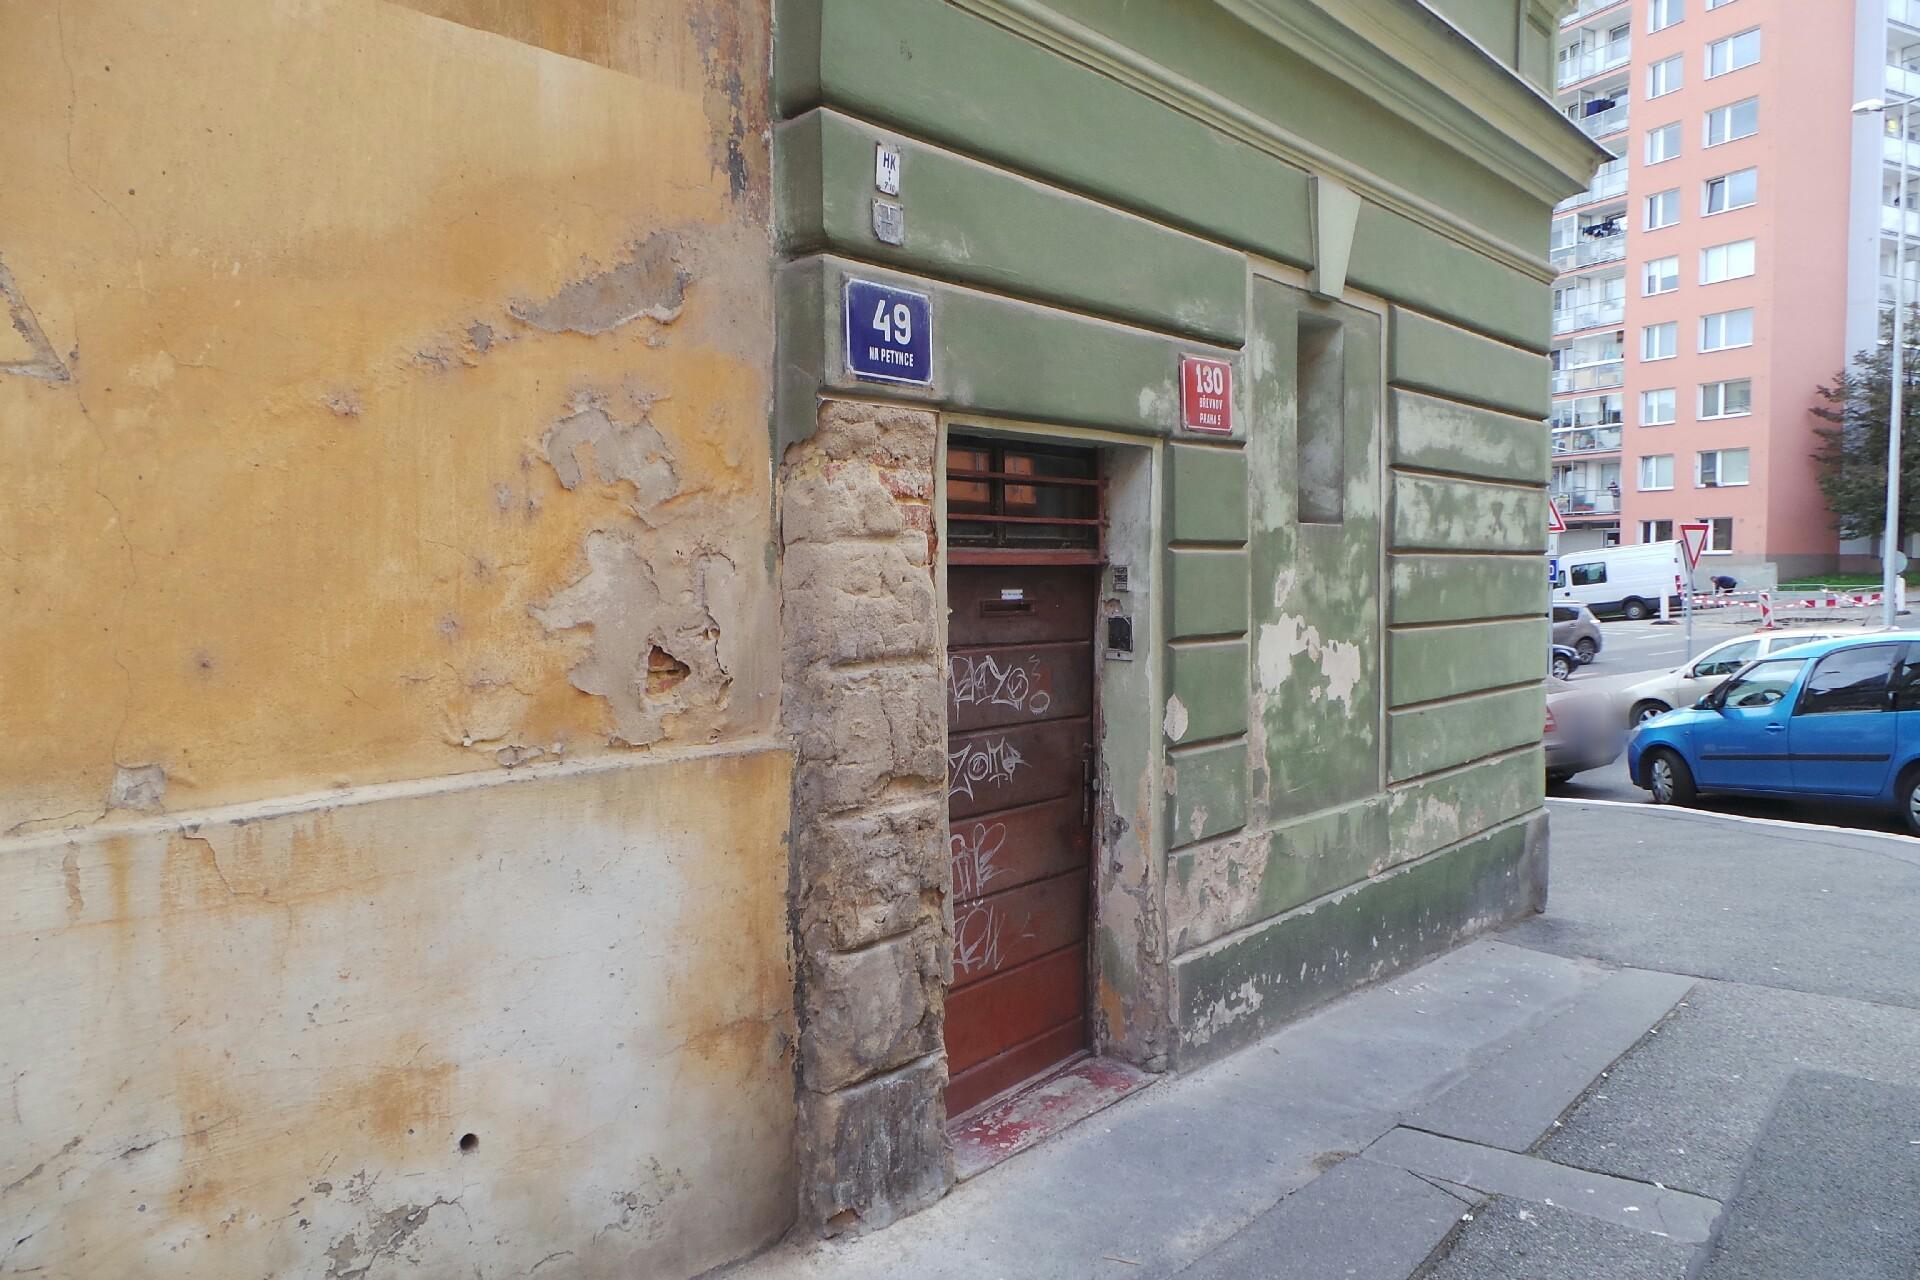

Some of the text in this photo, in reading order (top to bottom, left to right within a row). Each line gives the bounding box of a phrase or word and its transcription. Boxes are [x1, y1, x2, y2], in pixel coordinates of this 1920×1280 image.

[883, 152, 896, 171] HK
[872, 299, 912, 345] 49
[869, 346, 914, 368] NA PETYNCE
[1195, 364, 1224, 395] 130
[1199, 395, 1223, 411] BŘEVNOV
[1199, 412, 1222, 426] PRAHA 5
